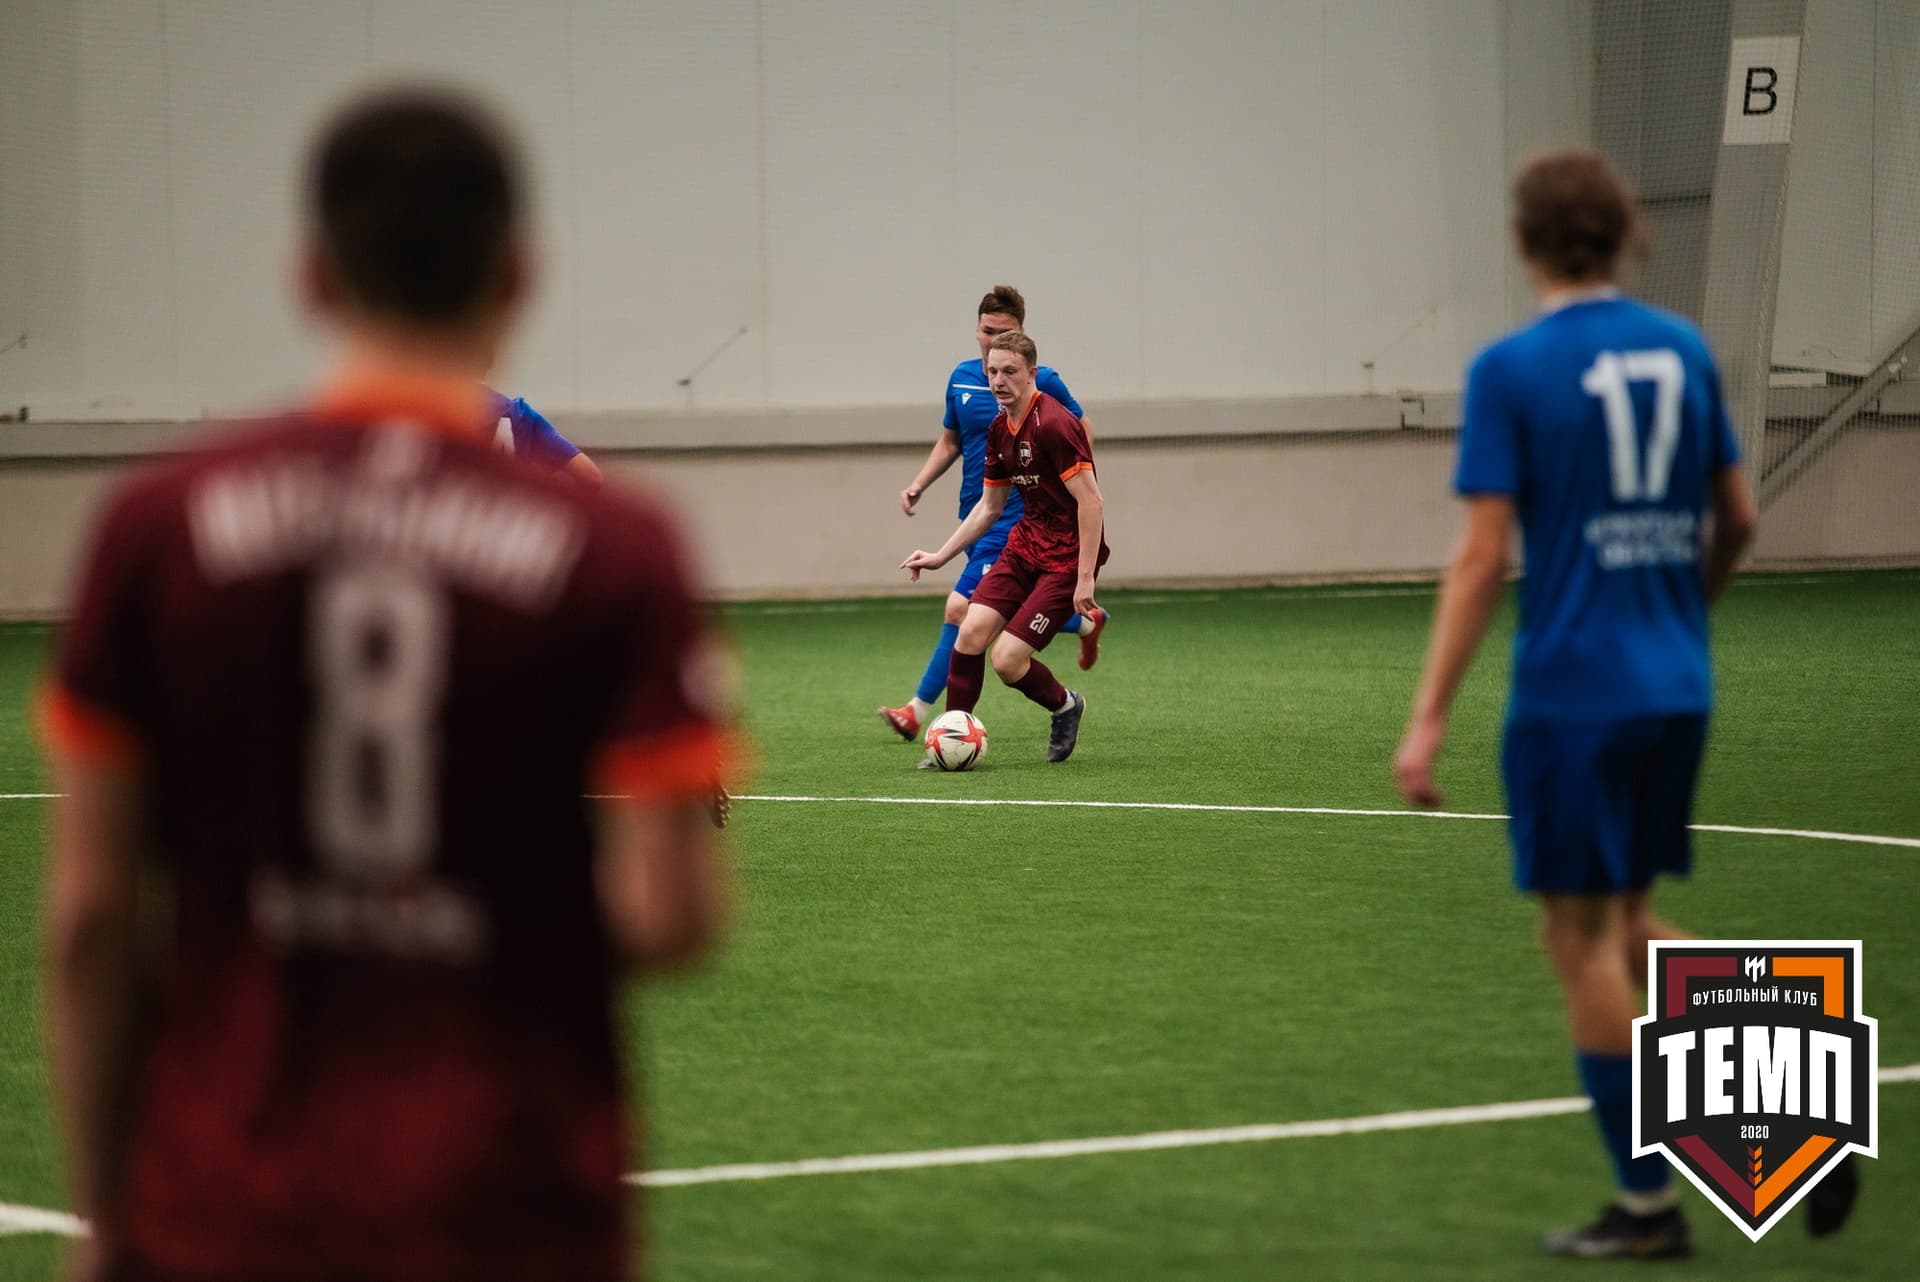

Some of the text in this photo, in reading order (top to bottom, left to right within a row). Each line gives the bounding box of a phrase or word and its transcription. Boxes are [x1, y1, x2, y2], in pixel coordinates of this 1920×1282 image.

[1581, 350, 1684, 502] 17
[1029, 613, 1050, 634] 20
[308, 574, 446, 868] 8
